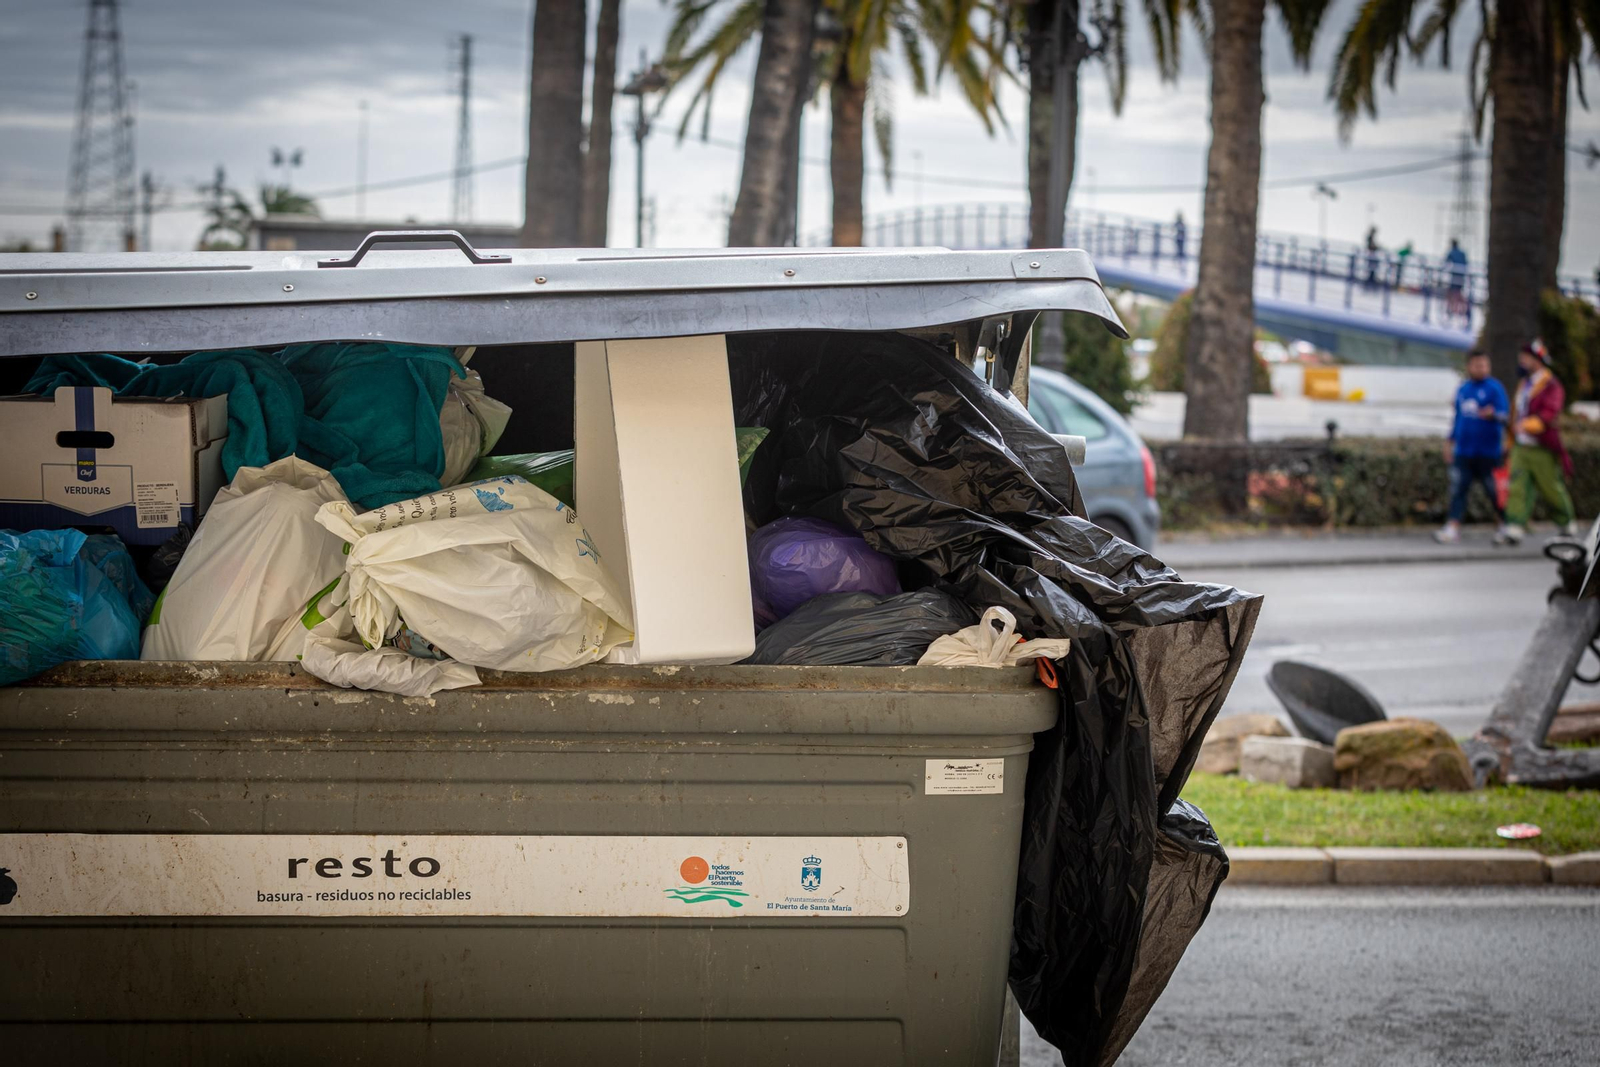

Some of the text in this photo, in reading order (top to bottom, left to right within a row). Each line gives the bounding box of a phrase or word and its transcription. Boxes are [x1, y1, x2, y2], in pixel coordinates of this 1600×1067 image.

[80, 469, 94, 477] Chef
[64, 486, 111, 495] VERDURAS
[288, 849, 441, 878] resto
[257, 890, 304, 903] basura
[315, 889, 374, 901] residuos
[378, 892, 396, 901] no
[399, 888, 472, 901] reciclables
[784, 896, 827, 904] Ayuntamiento
